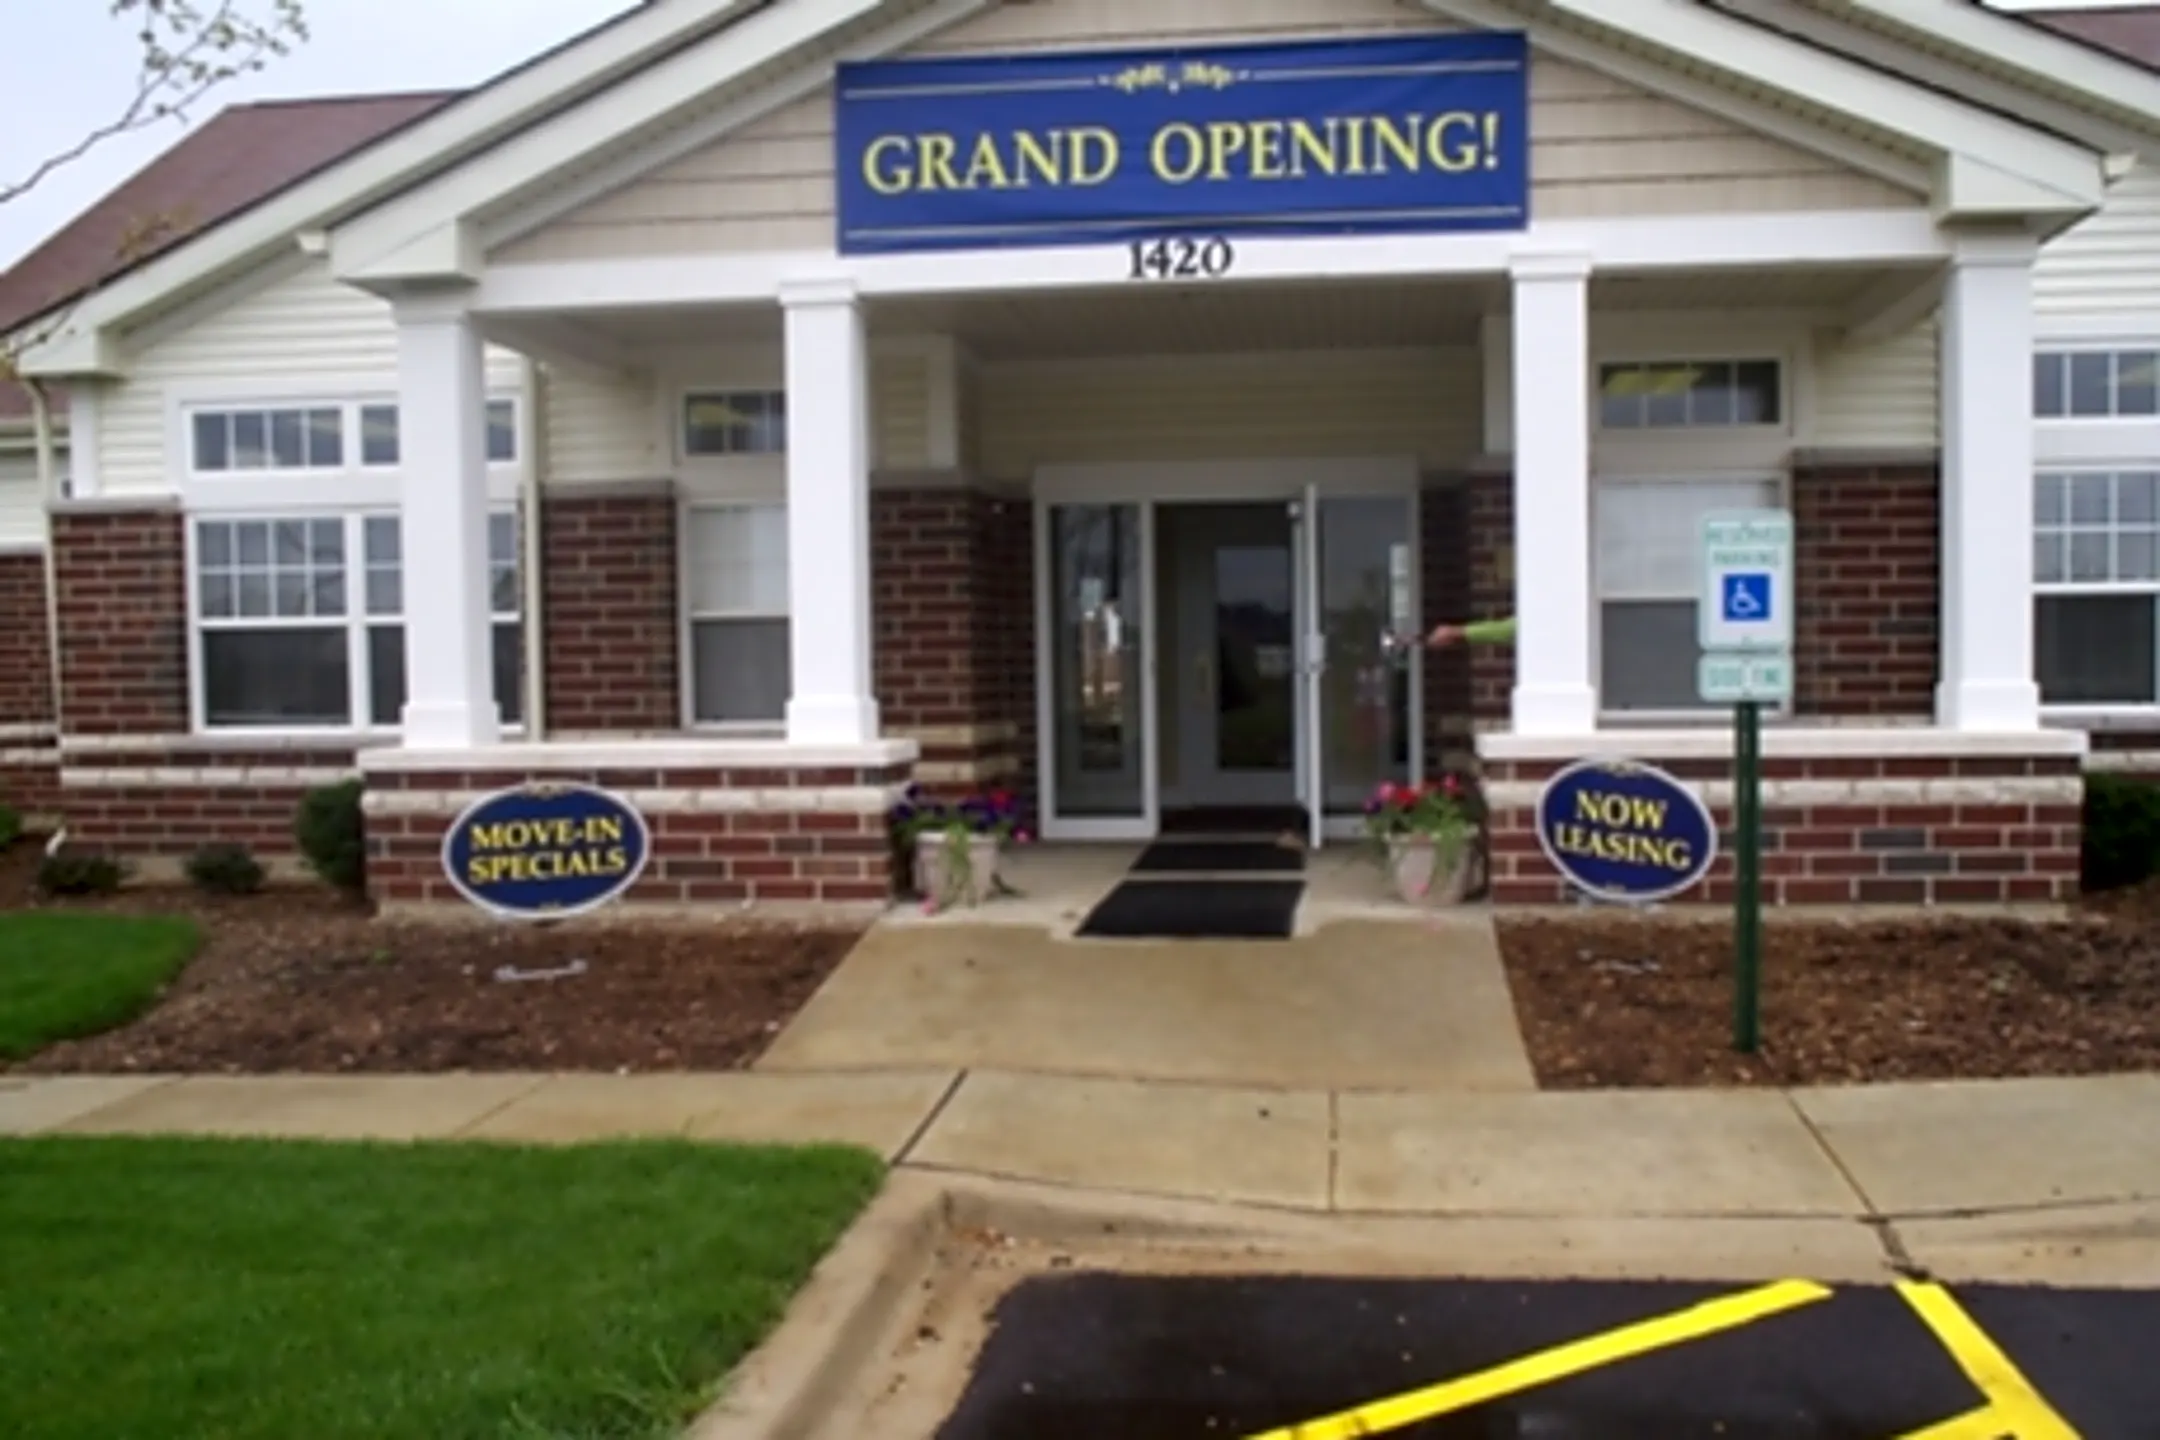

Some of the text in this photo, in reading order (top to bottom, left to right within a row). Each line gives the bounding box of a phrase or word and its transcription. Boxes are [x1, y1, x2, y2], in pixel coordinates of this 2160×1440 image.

[862, 112, 1500, 194] GRAND OPENING!
[1129, 237, 1233, 279] 1420
[1575, 789, 1668, 831] NOW
[470, 816, 622, 848] MOVE-IN
[1554, 822, 1691, 871] LEASING
[469, 847, 627, 884] SPECIALS
